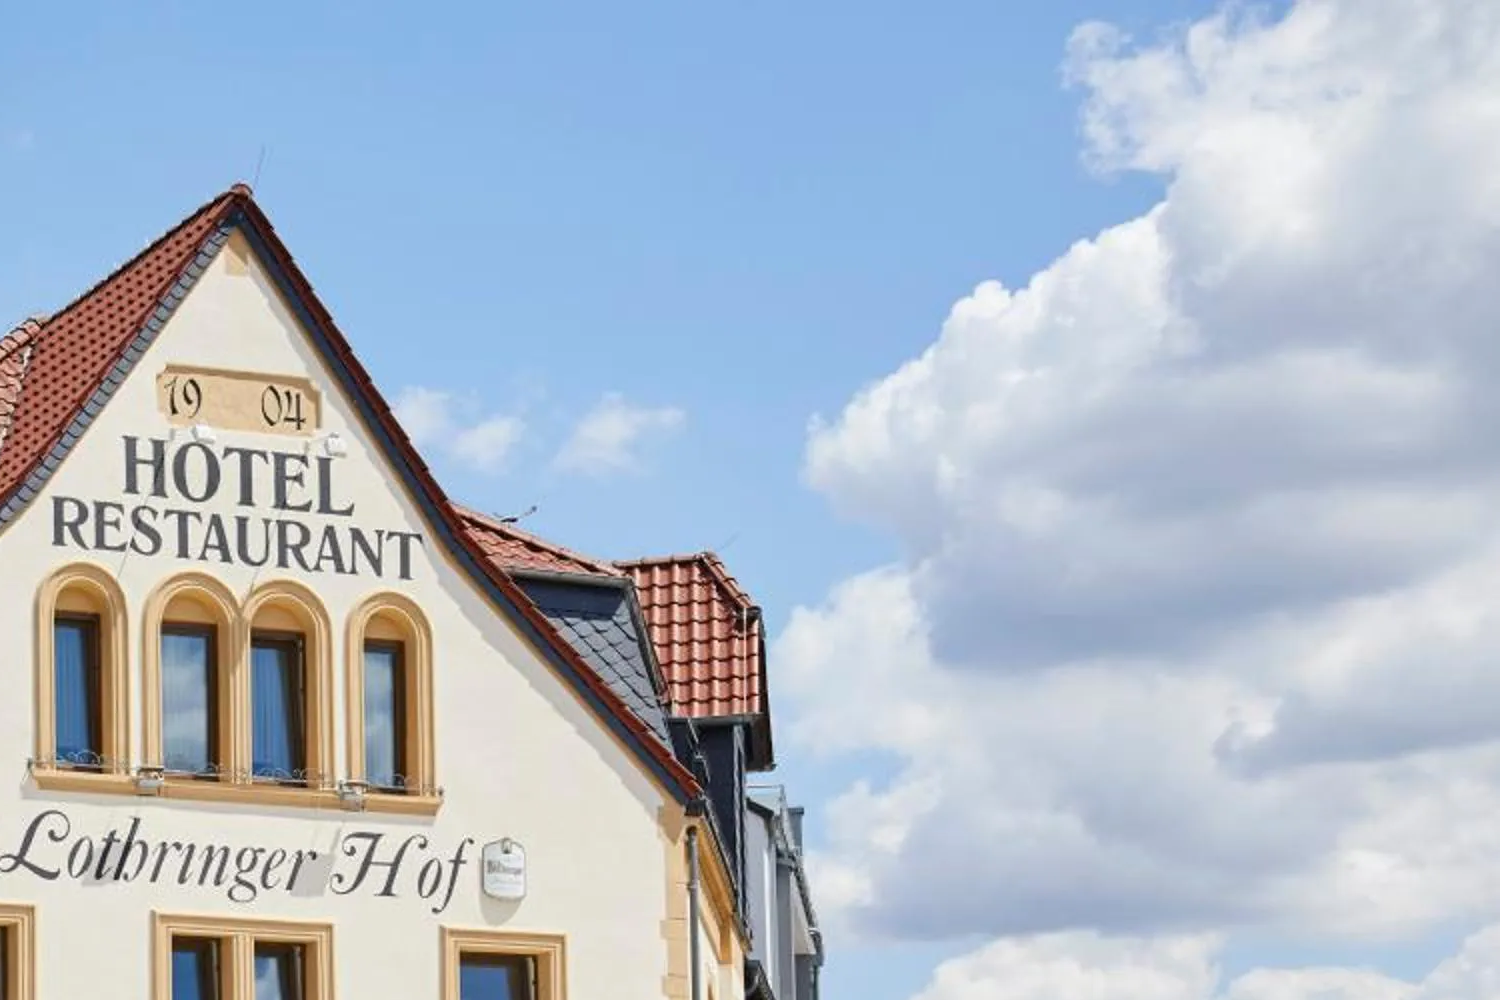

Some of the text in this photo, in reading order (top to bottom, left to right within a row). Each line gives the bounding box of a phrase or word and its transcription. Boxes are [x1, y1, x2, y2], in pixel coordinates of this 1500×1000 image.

[260, 384, 306, 431] 04
[121, 434, 356, 517] HOTEL
[51, 496, 424, 580] RESTAURANT
[330, 831, 475, 914] Hof
